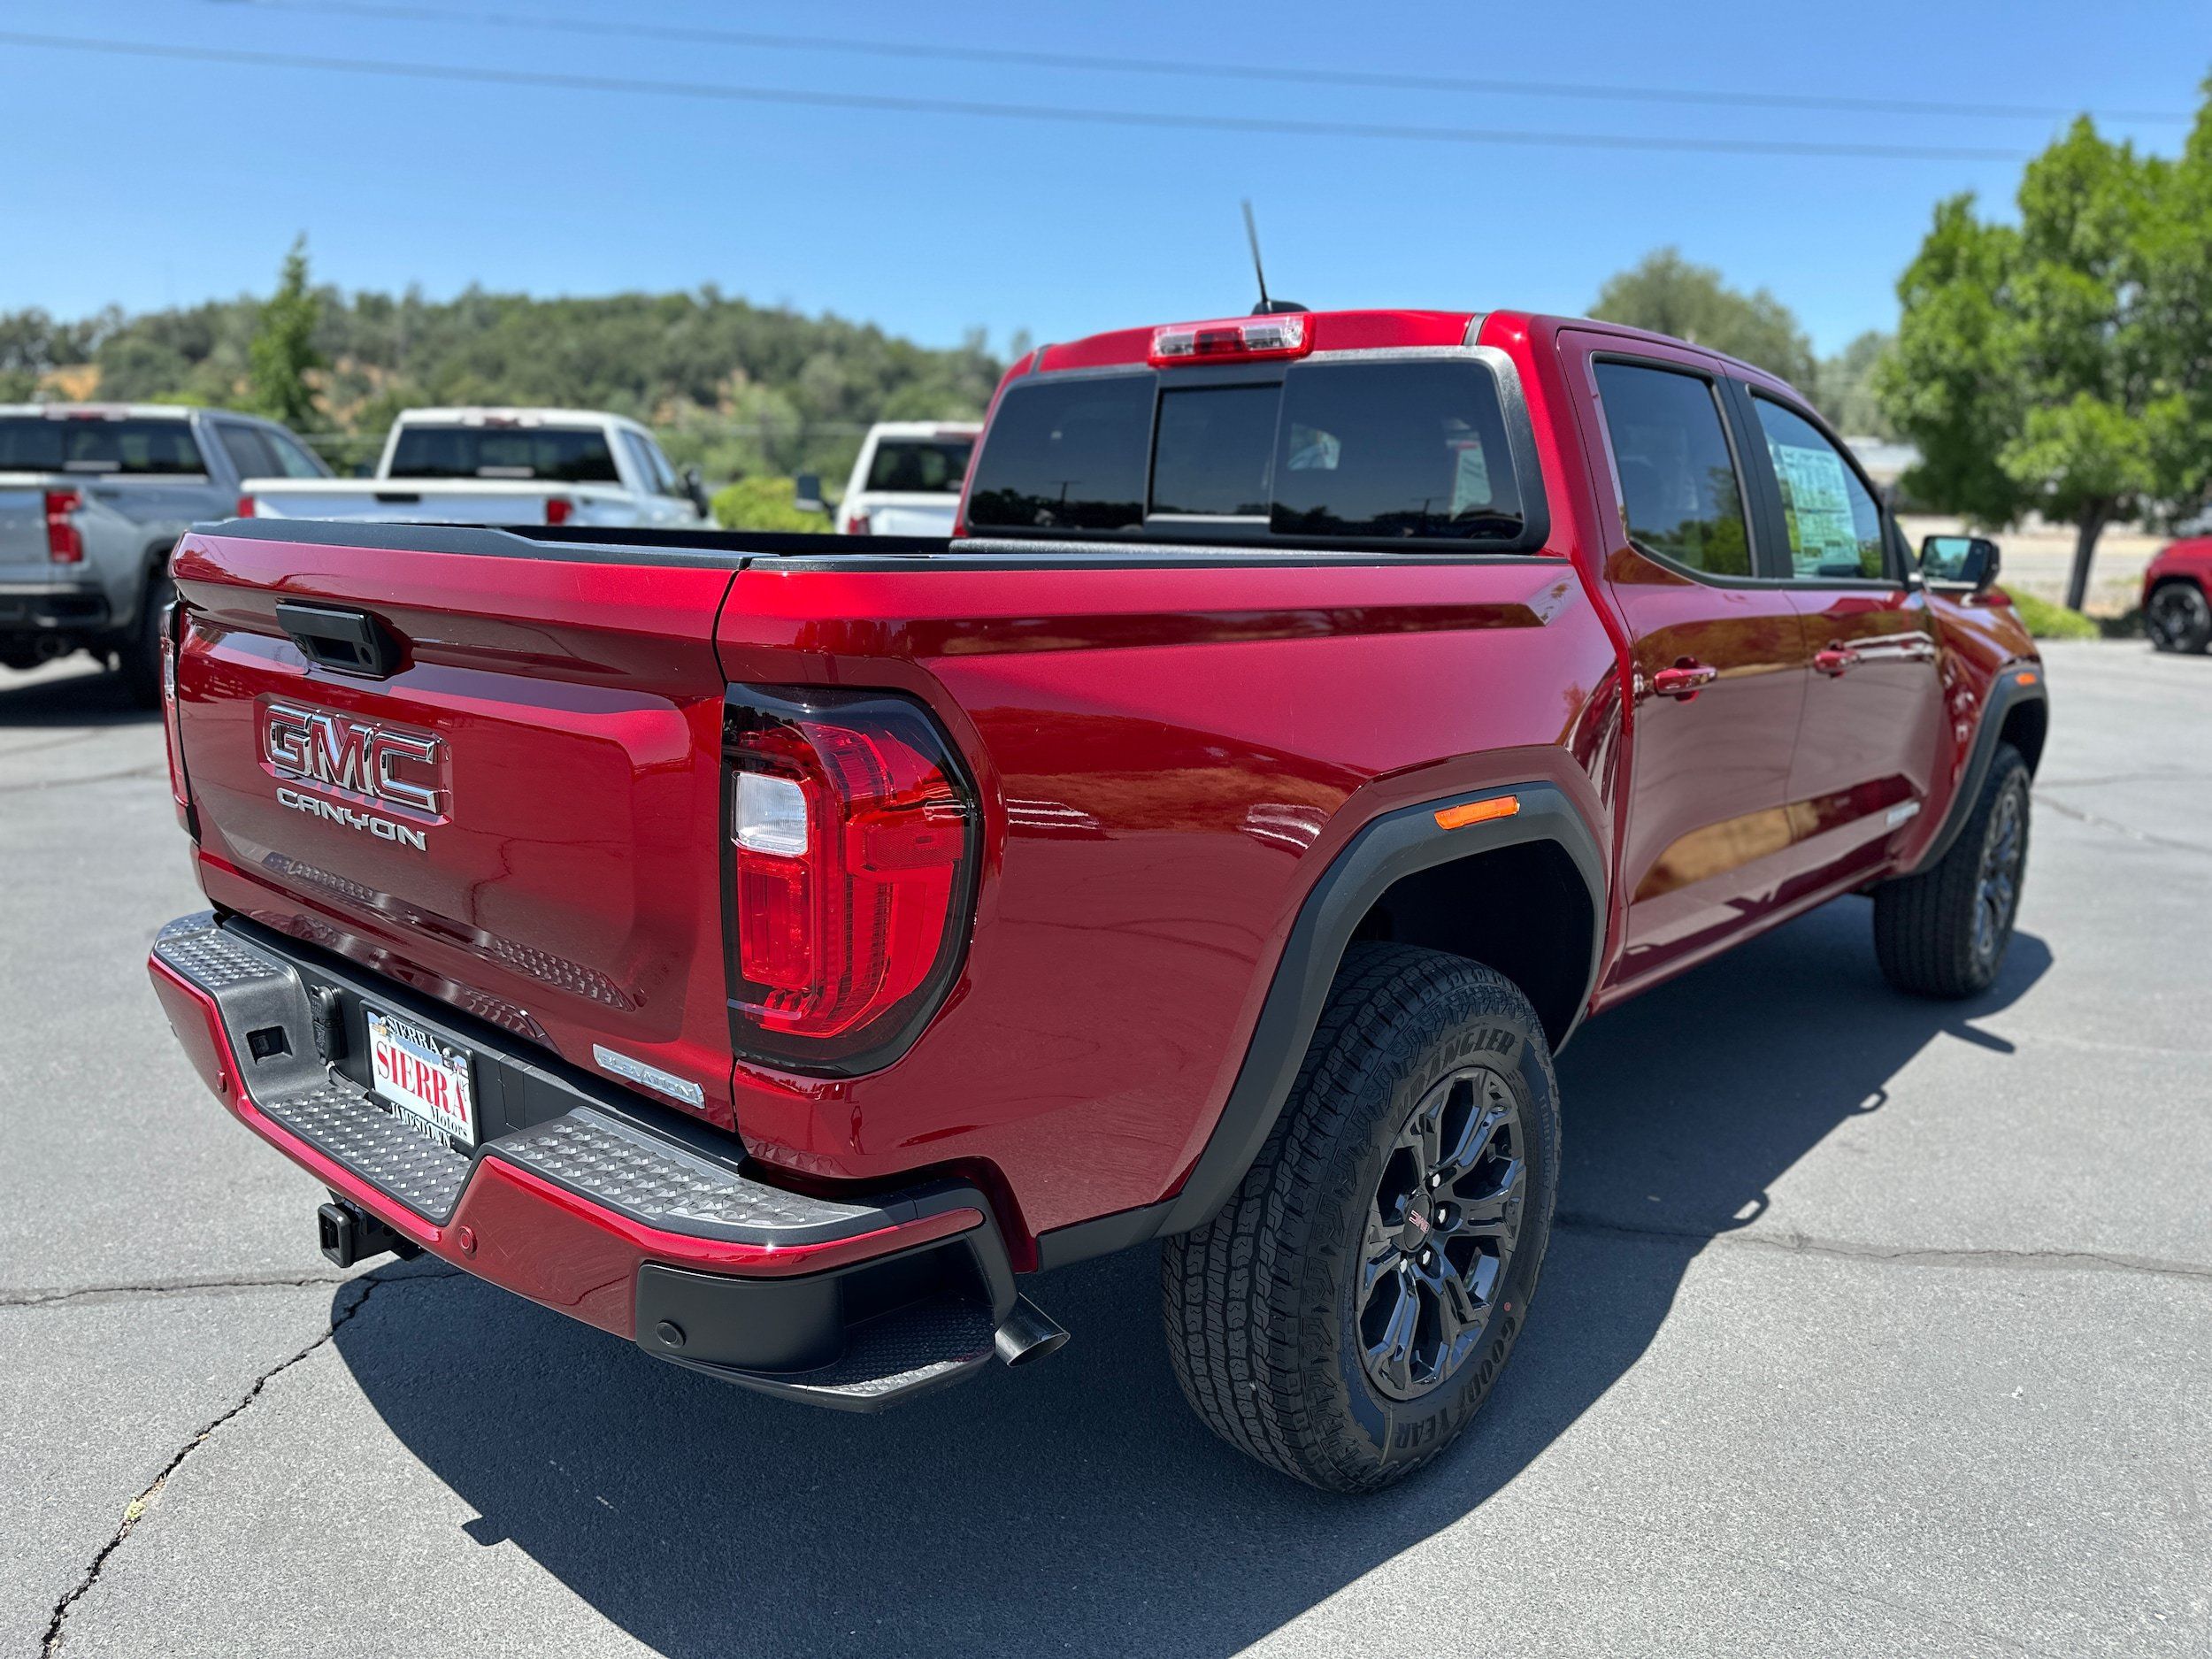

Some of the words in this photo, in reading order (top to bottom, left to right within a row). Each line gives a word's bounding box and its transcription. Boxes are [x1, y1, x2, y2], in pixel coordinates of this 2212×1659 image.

[264, 705, 436, 813] GMC
[277, 787, 426, 851] CANYON
[387, 1015, 441, 1055] SIERRA
[377, 1041, 468, 1124] SIERRA
[431, 1105, 469, 1140] Motors
